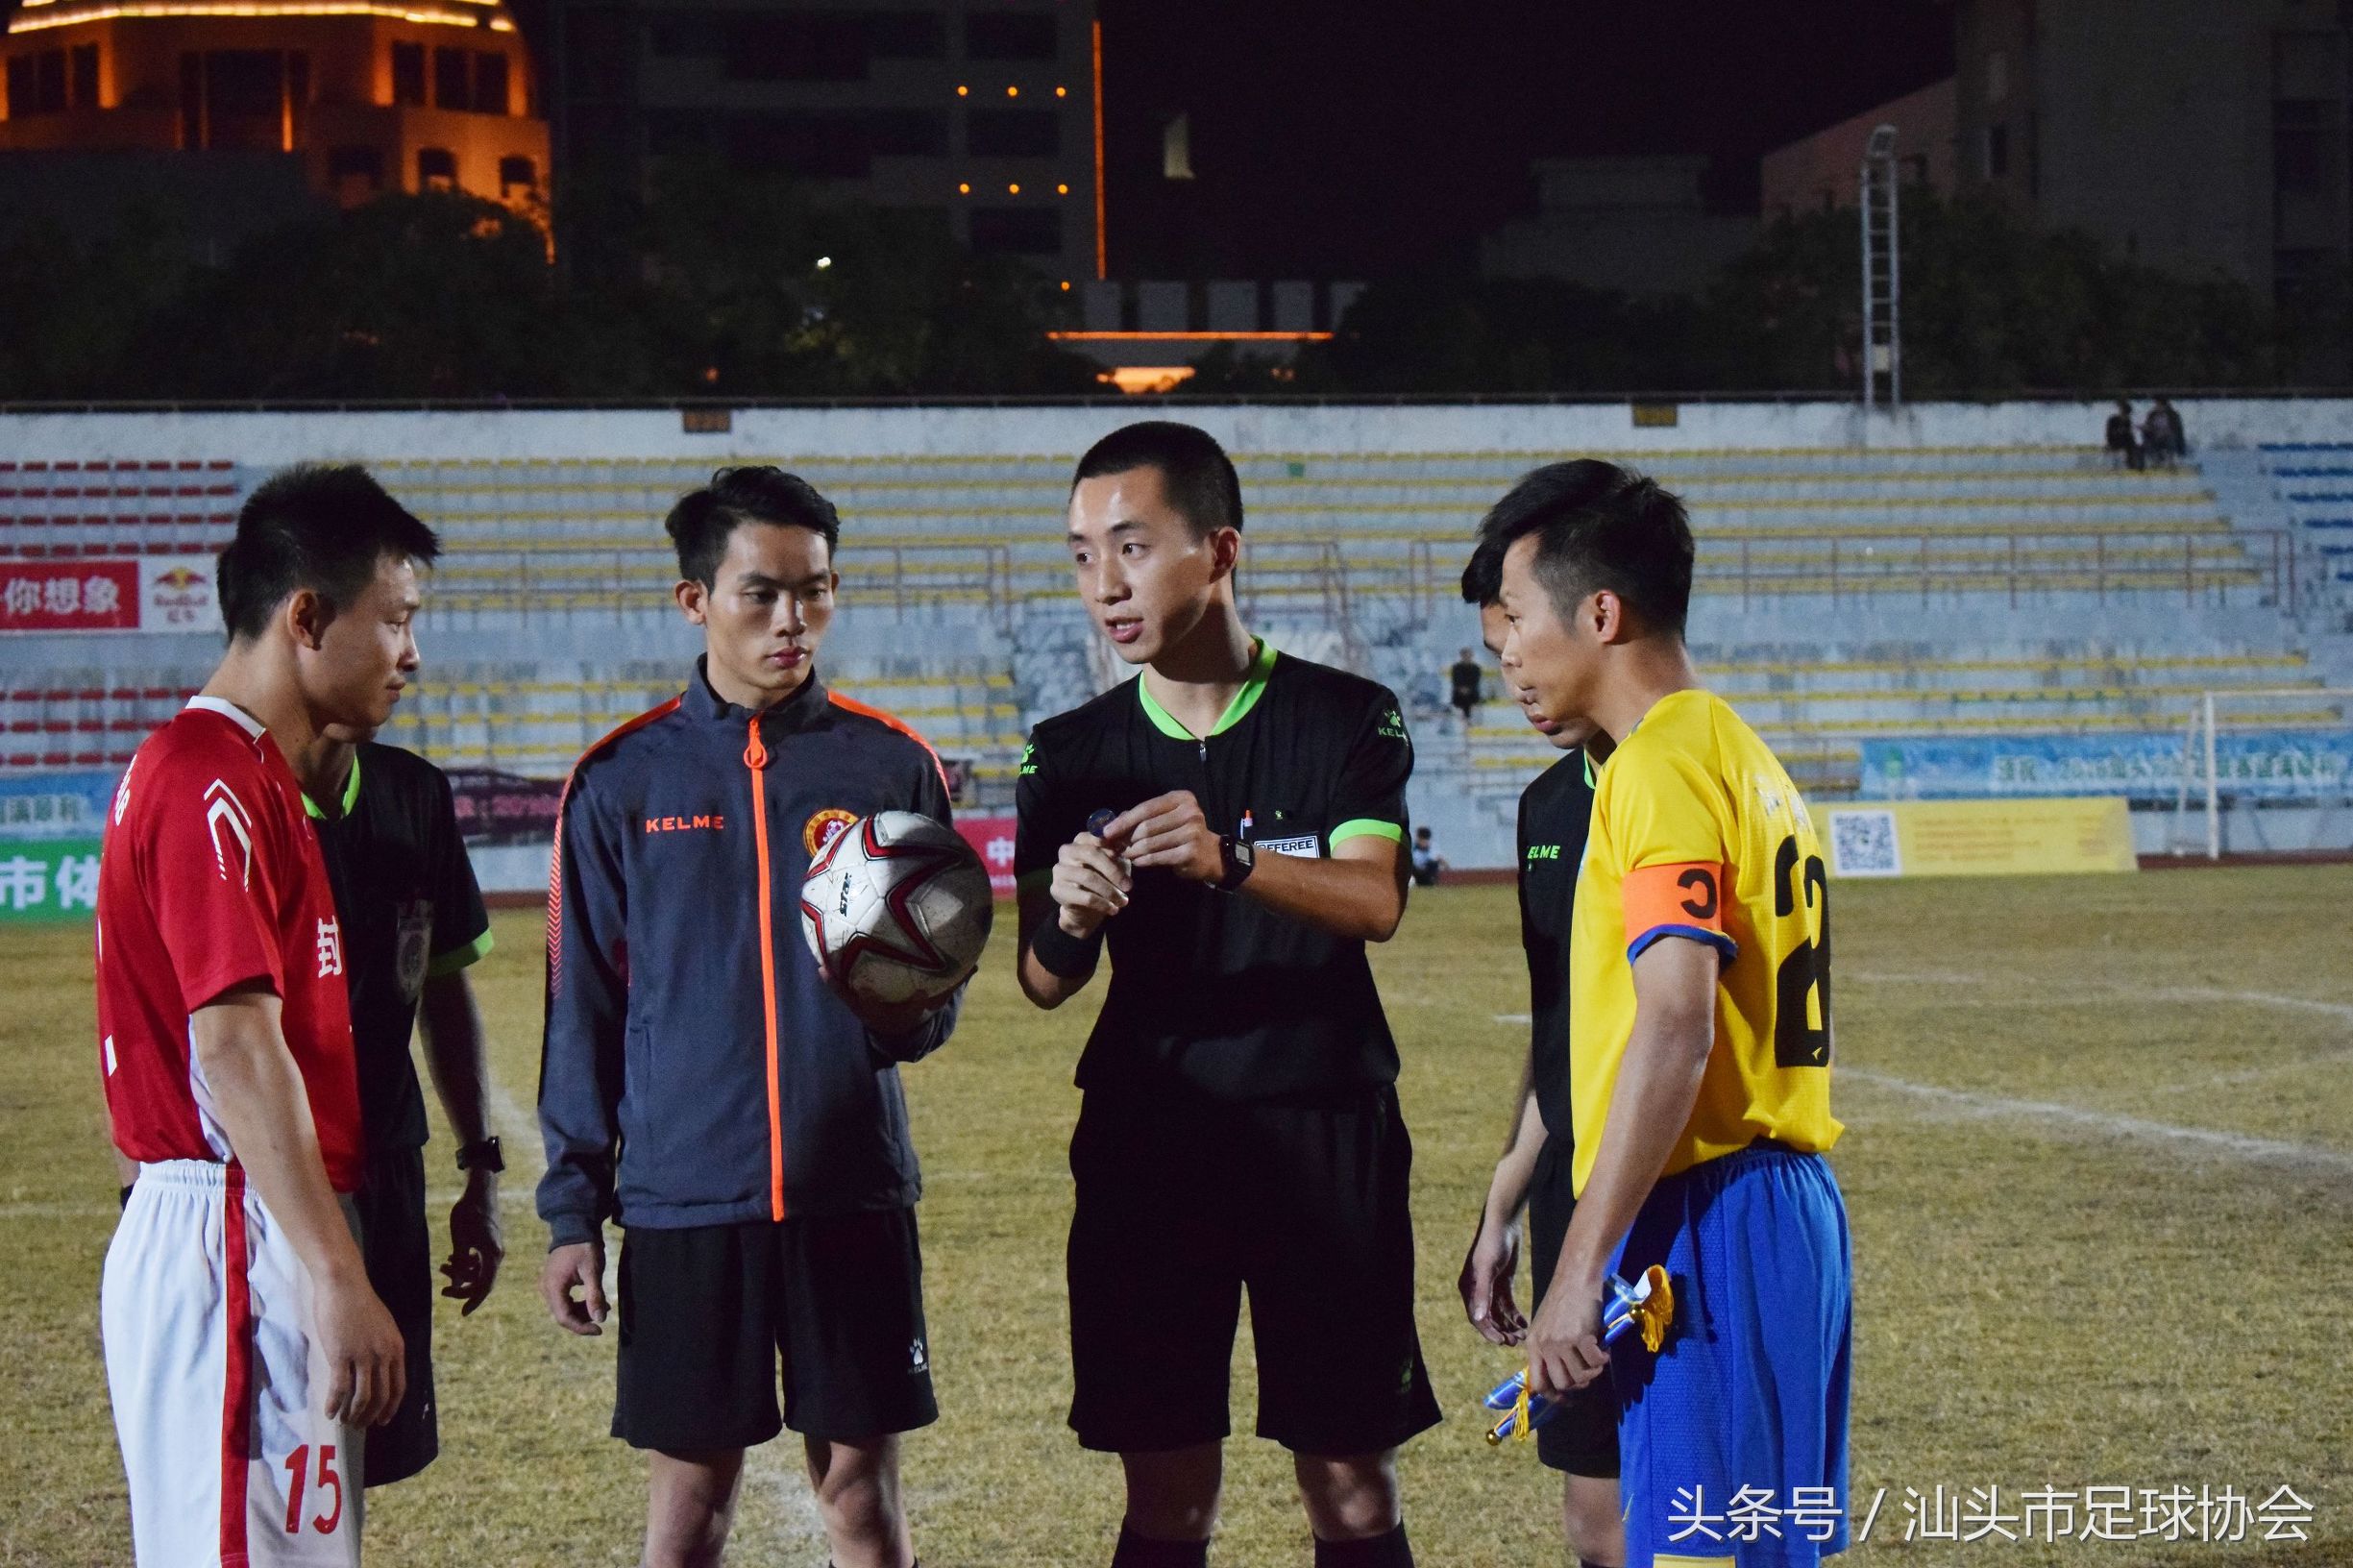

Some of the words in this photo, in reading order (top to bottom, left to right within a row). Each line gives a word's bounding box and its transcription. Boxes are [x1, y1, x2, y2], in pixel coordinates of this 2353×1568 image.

[0, 576, 121, 616] 你想象
[646, 815, 723, 834] KELME
[285, 1443, 342, 1535] 15
